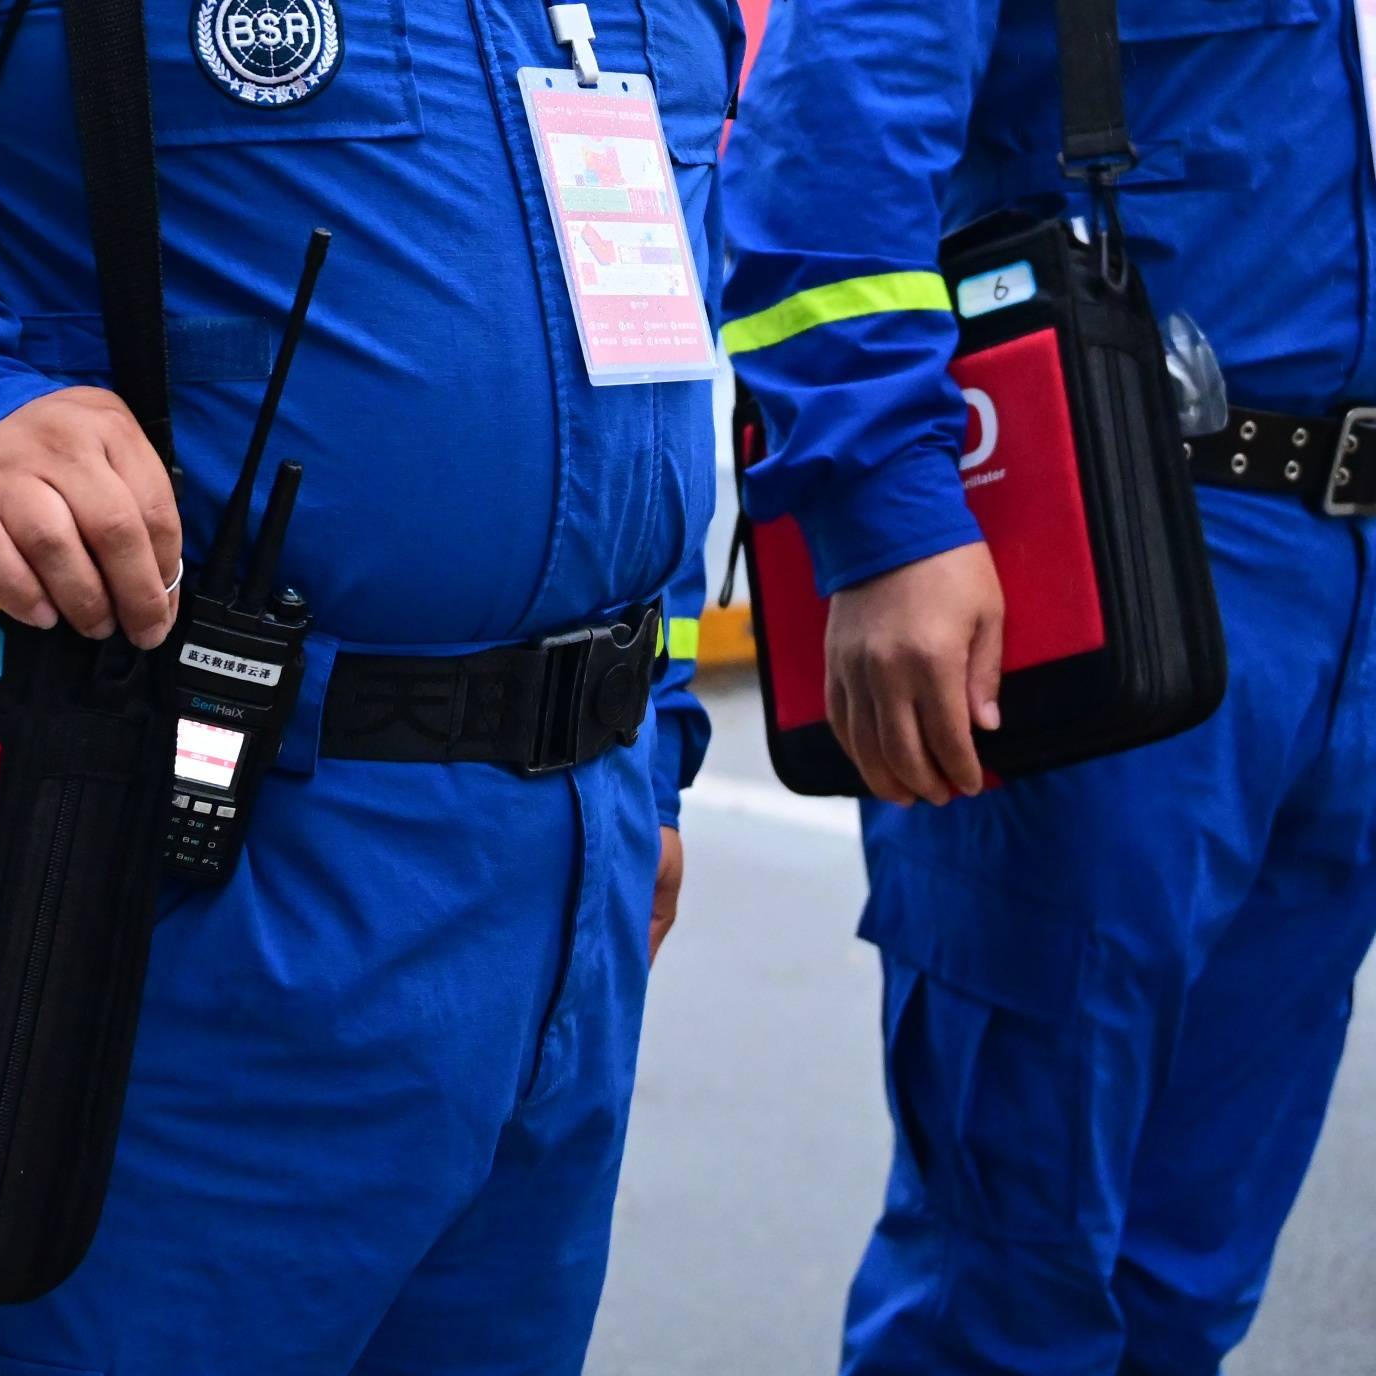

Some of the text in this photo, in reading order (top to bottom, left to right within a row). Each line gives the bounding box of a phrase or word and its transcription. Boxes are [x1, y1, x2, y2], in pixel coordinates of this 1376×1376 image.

[227, 11, 310, 48] BSR
[993, 275, 1010, 302] 6
[187, 649, 271, 679] 蓝天救援郭云泽
